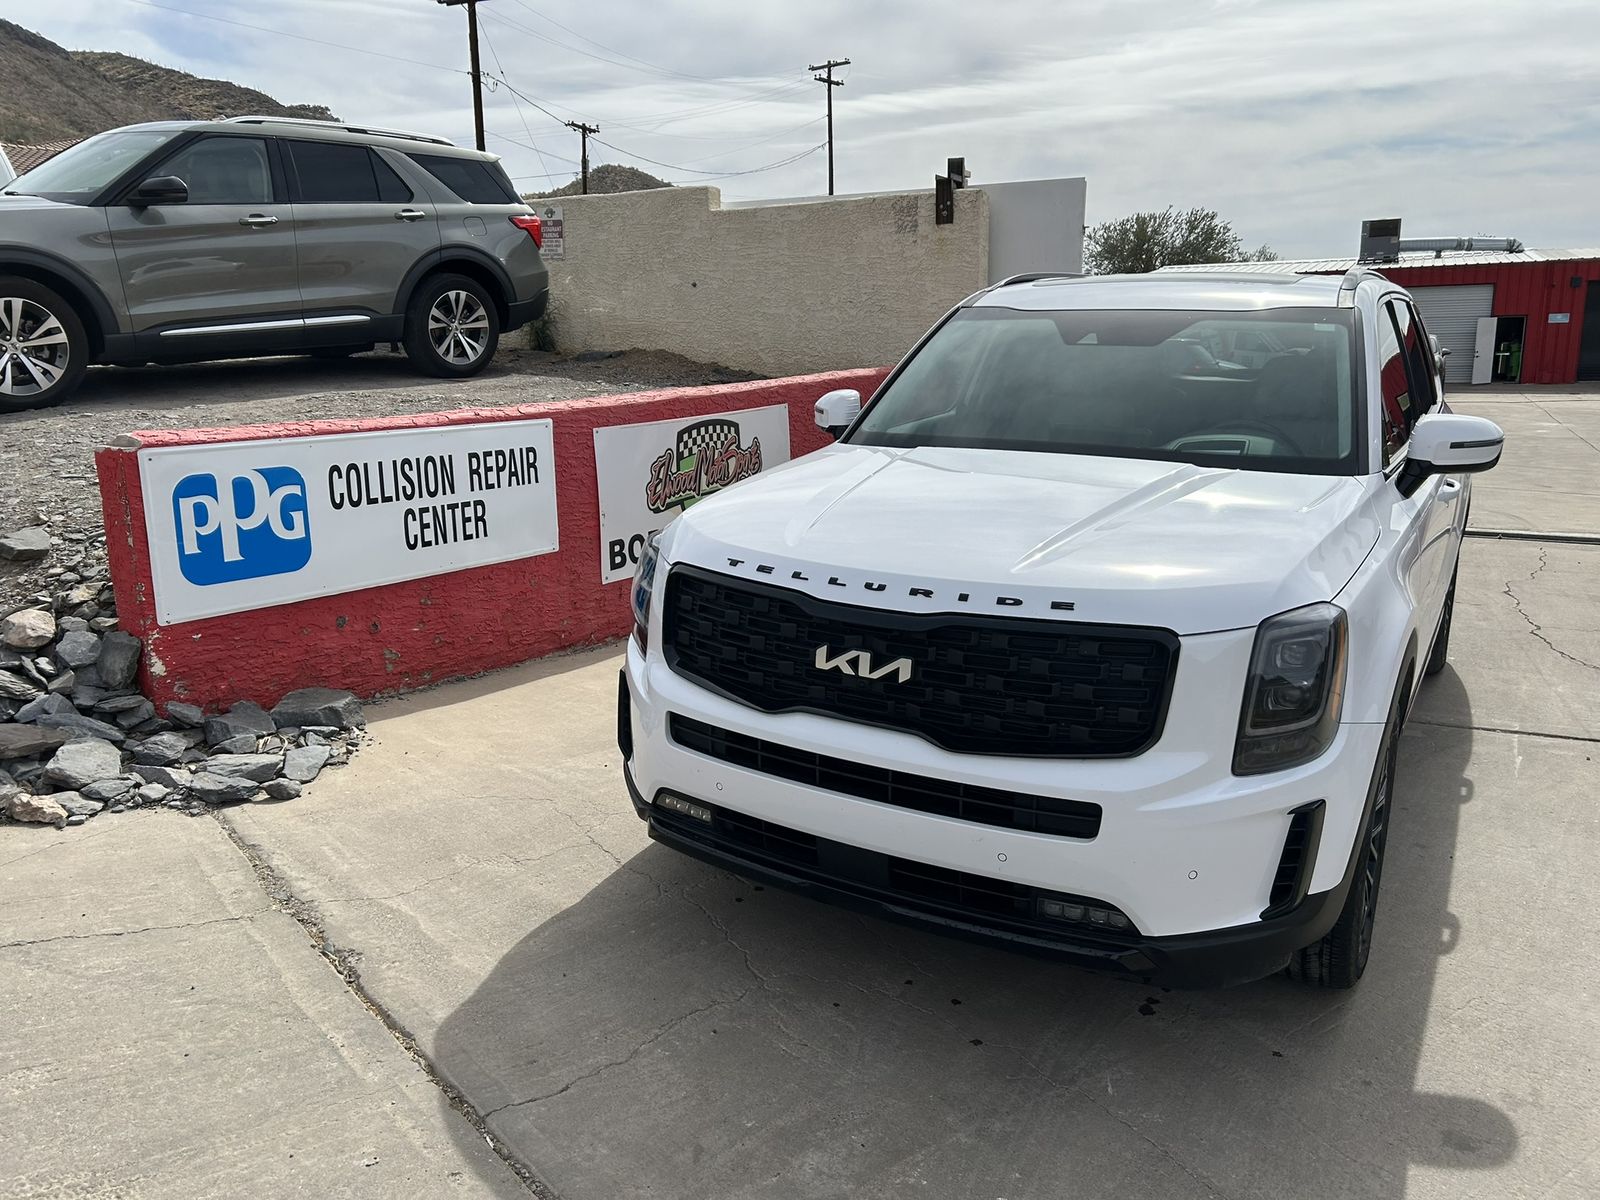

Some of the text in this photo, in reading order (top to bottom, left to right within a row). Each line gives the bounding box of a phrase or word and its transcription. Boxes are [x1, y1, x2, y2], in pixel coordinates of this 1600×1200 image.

[328, 446, 540, 510] COLLISION REPAIR
[403, 499, 489, 551] CENTER
[608, 528, 659, 571] BO
[727, 557, 1075, 611] TELLURIDE
[815, 644, 912, 683] KIA
